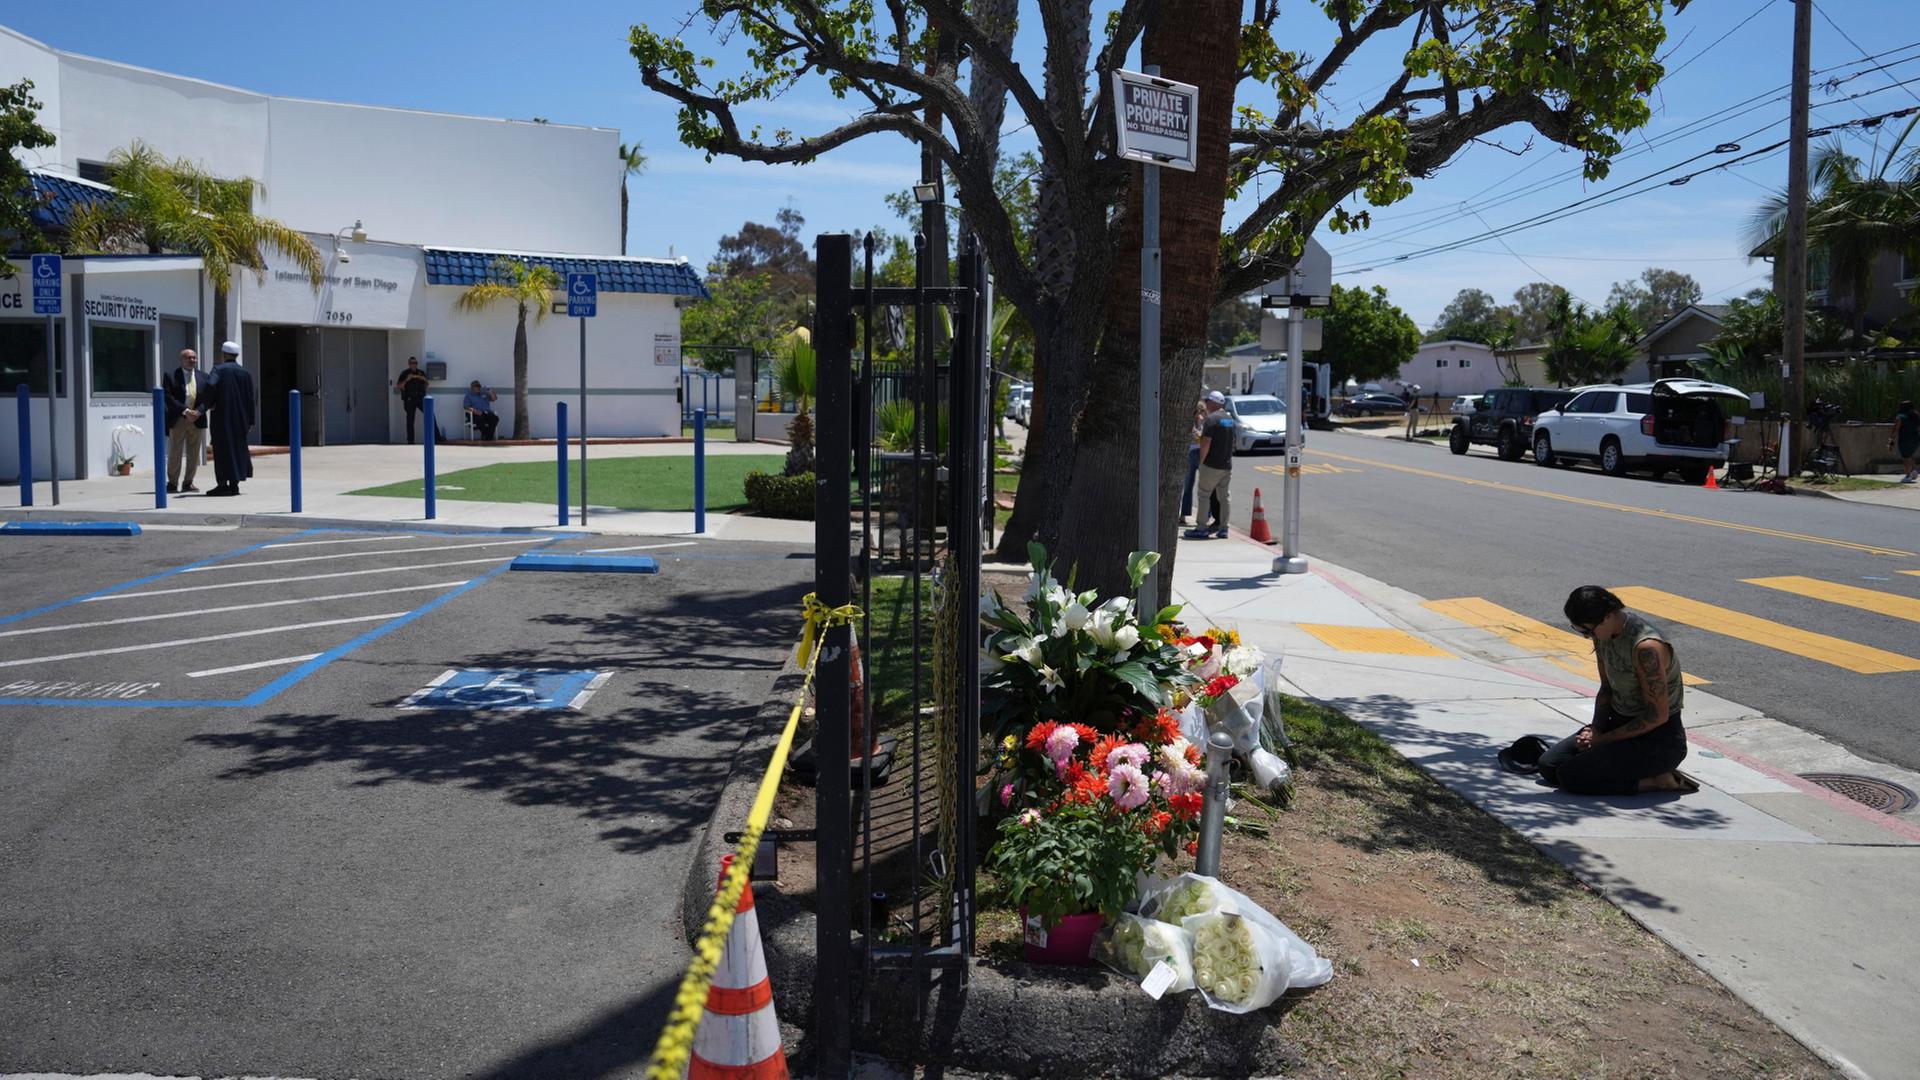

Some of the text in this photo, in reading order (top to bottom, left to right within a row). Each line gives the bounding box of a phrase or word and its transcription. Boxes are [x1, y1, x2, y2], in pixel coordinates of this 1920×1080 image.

[1133, 87, 1183, 112] PRIVATE
[1126, 104, 1188, 131] PROPERTY
[1127, 122, 1188, 140] NO TRESPASSING
[34, 279, 60, 288] PARKING
[275, 270, 310, 281] Islamic
[343, 277, 352, 285] of
[354, 277, 372, 287] San
[374, 278, 397, 292] Diego
[39, 288, 56, 297] ONLY
[0, 293, 22, 308] CE
[569, 296, 596, 305] PARKING
[85, 300, 157, 321] SECURITY OFFICE
[326, 311, 352, 321] 7050
[574, 305, 591, 315] ONLY
